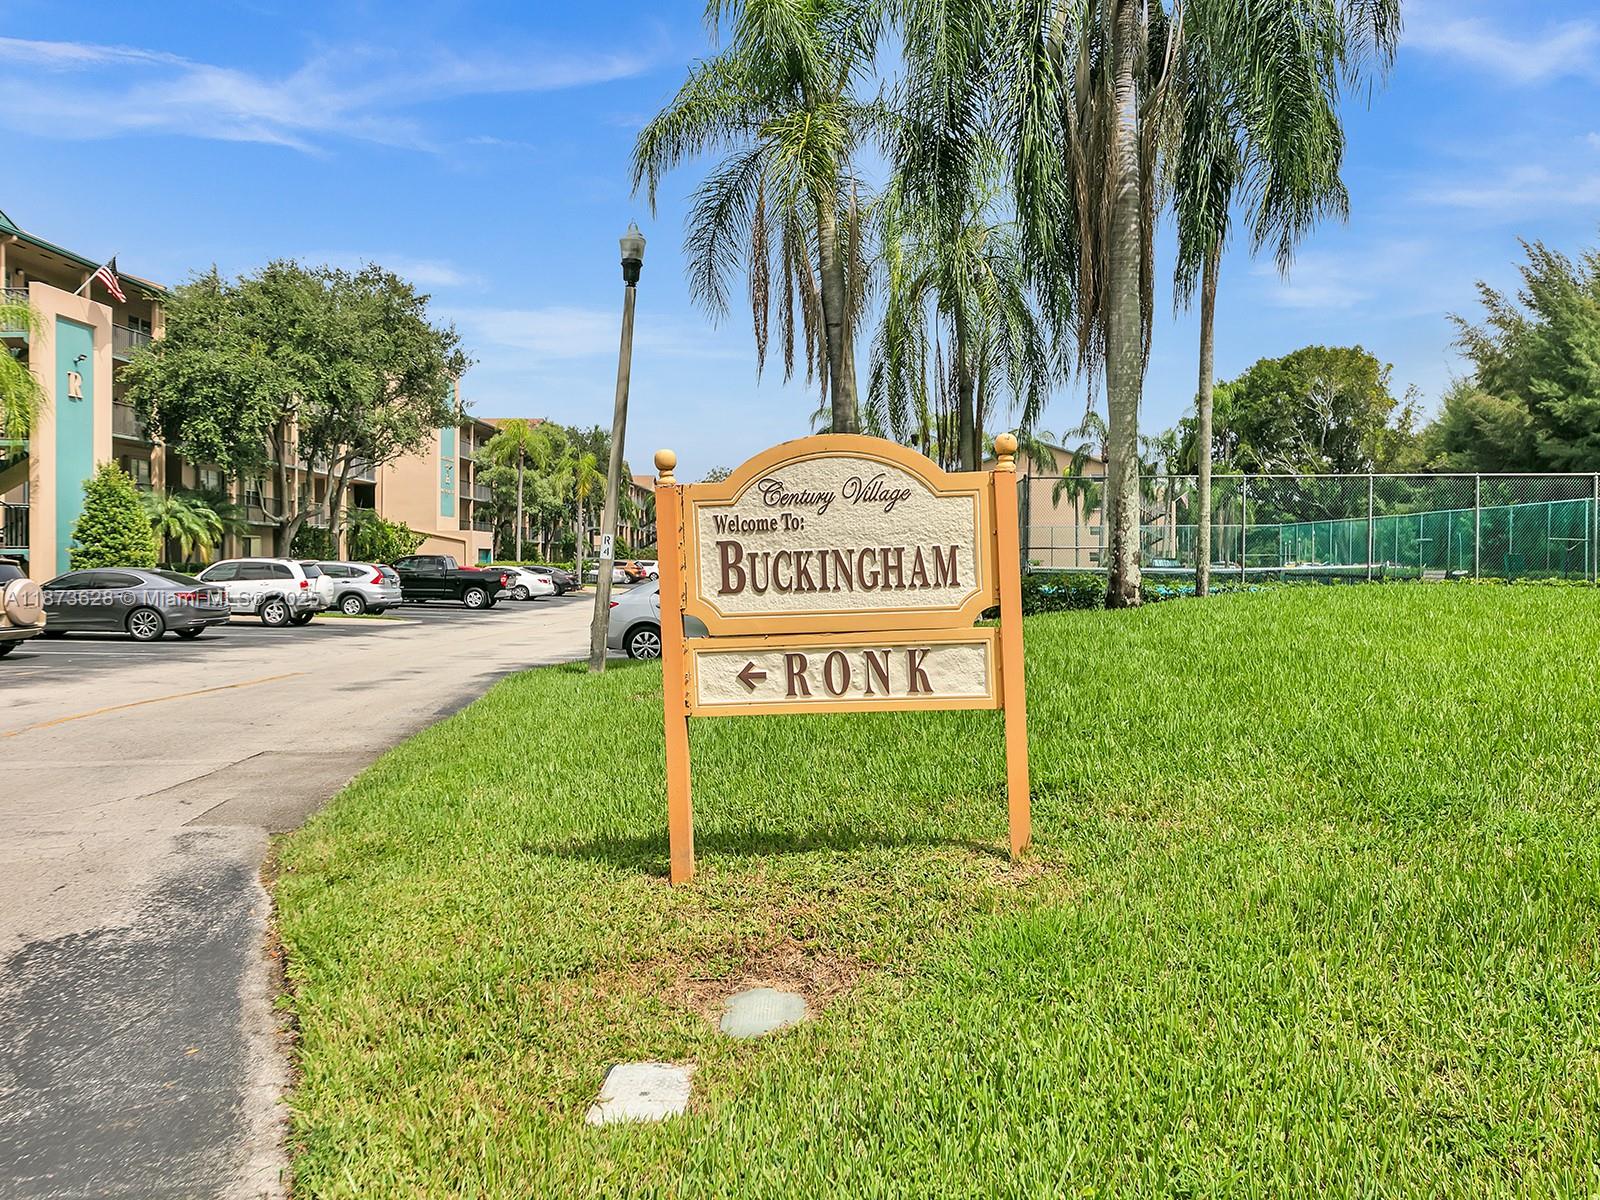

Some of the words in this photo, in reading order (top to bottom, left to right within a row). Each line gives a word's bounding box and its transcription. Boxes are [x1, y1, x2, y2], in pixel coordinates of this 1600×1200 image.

[67, 371, 84, 400] R
[758, 478, 836, 515] Century
[842, 473, 912, 513] Village
[713, 514, 778, 534] Welcome
[780, 513, 805, 531] To:
[603, 535, 611, 545] R
[716, 540, 961, 596] BUCKINGHAM
